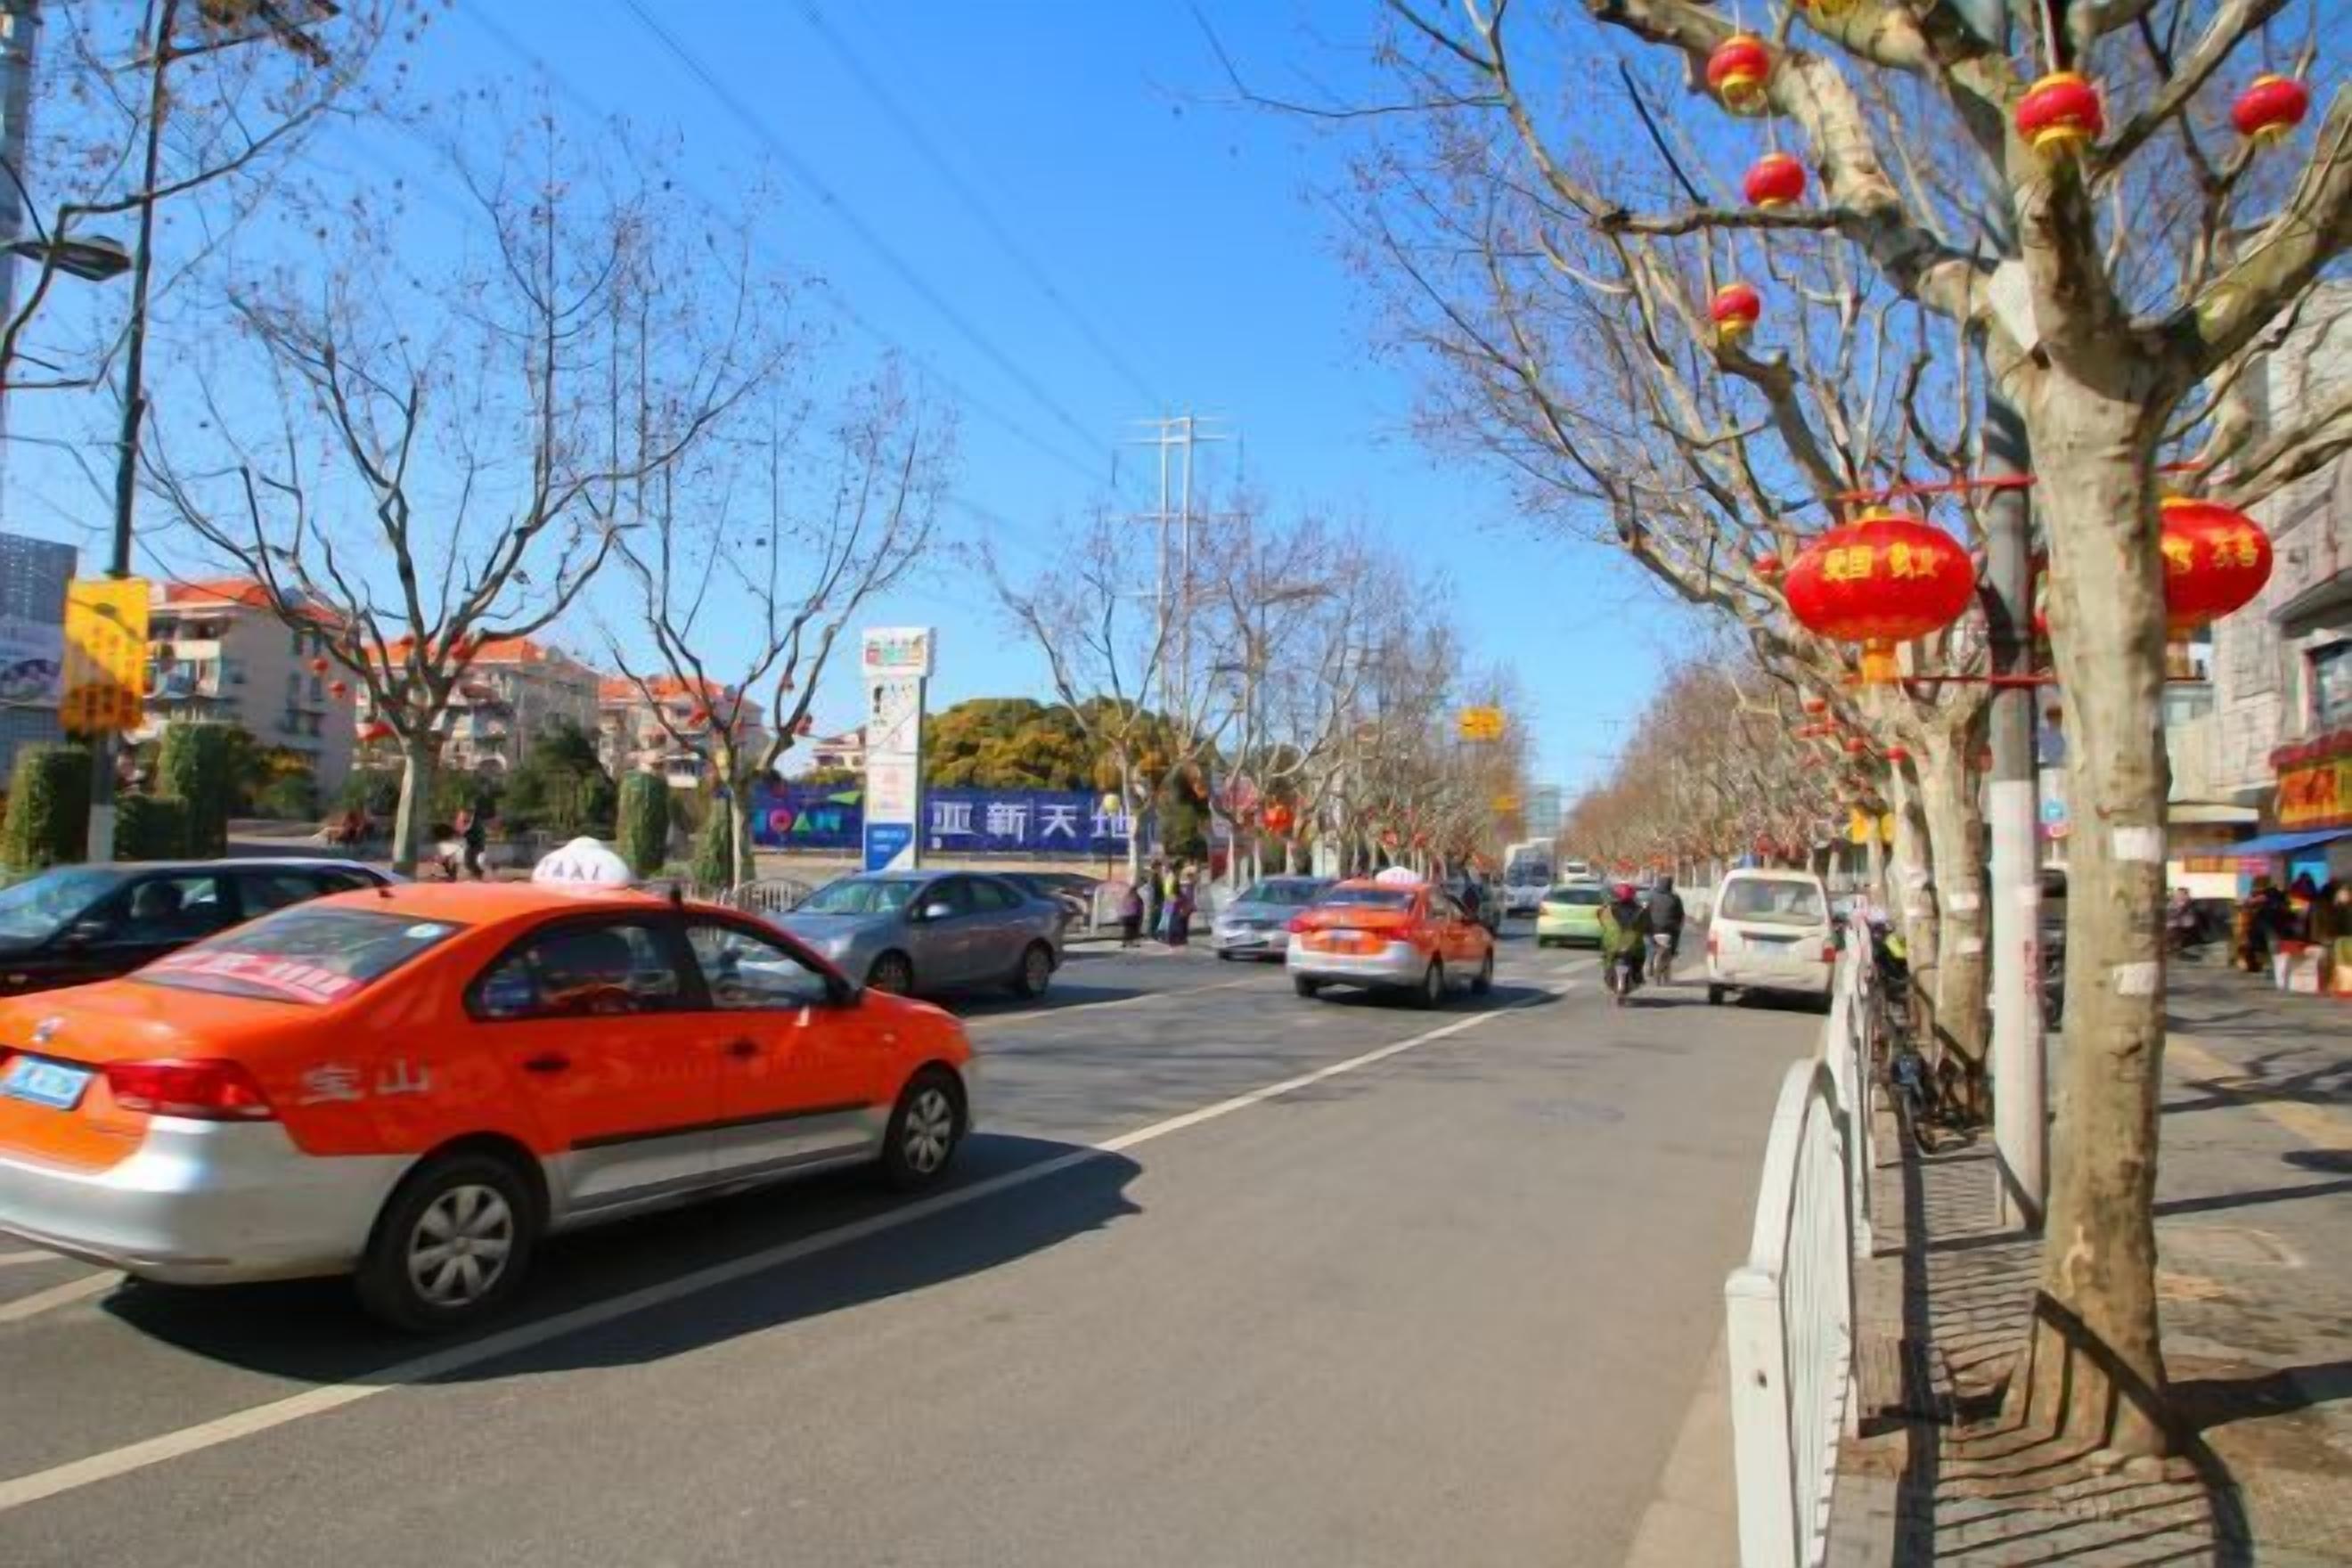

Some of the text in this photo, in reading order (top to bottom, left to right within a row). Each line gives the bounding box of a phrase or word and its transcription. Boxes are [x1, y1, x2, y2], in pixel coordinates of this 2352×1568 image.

[930, 800, 1131, 843] 亚新天地
[298, 1059, 429, 1106] 宝山
